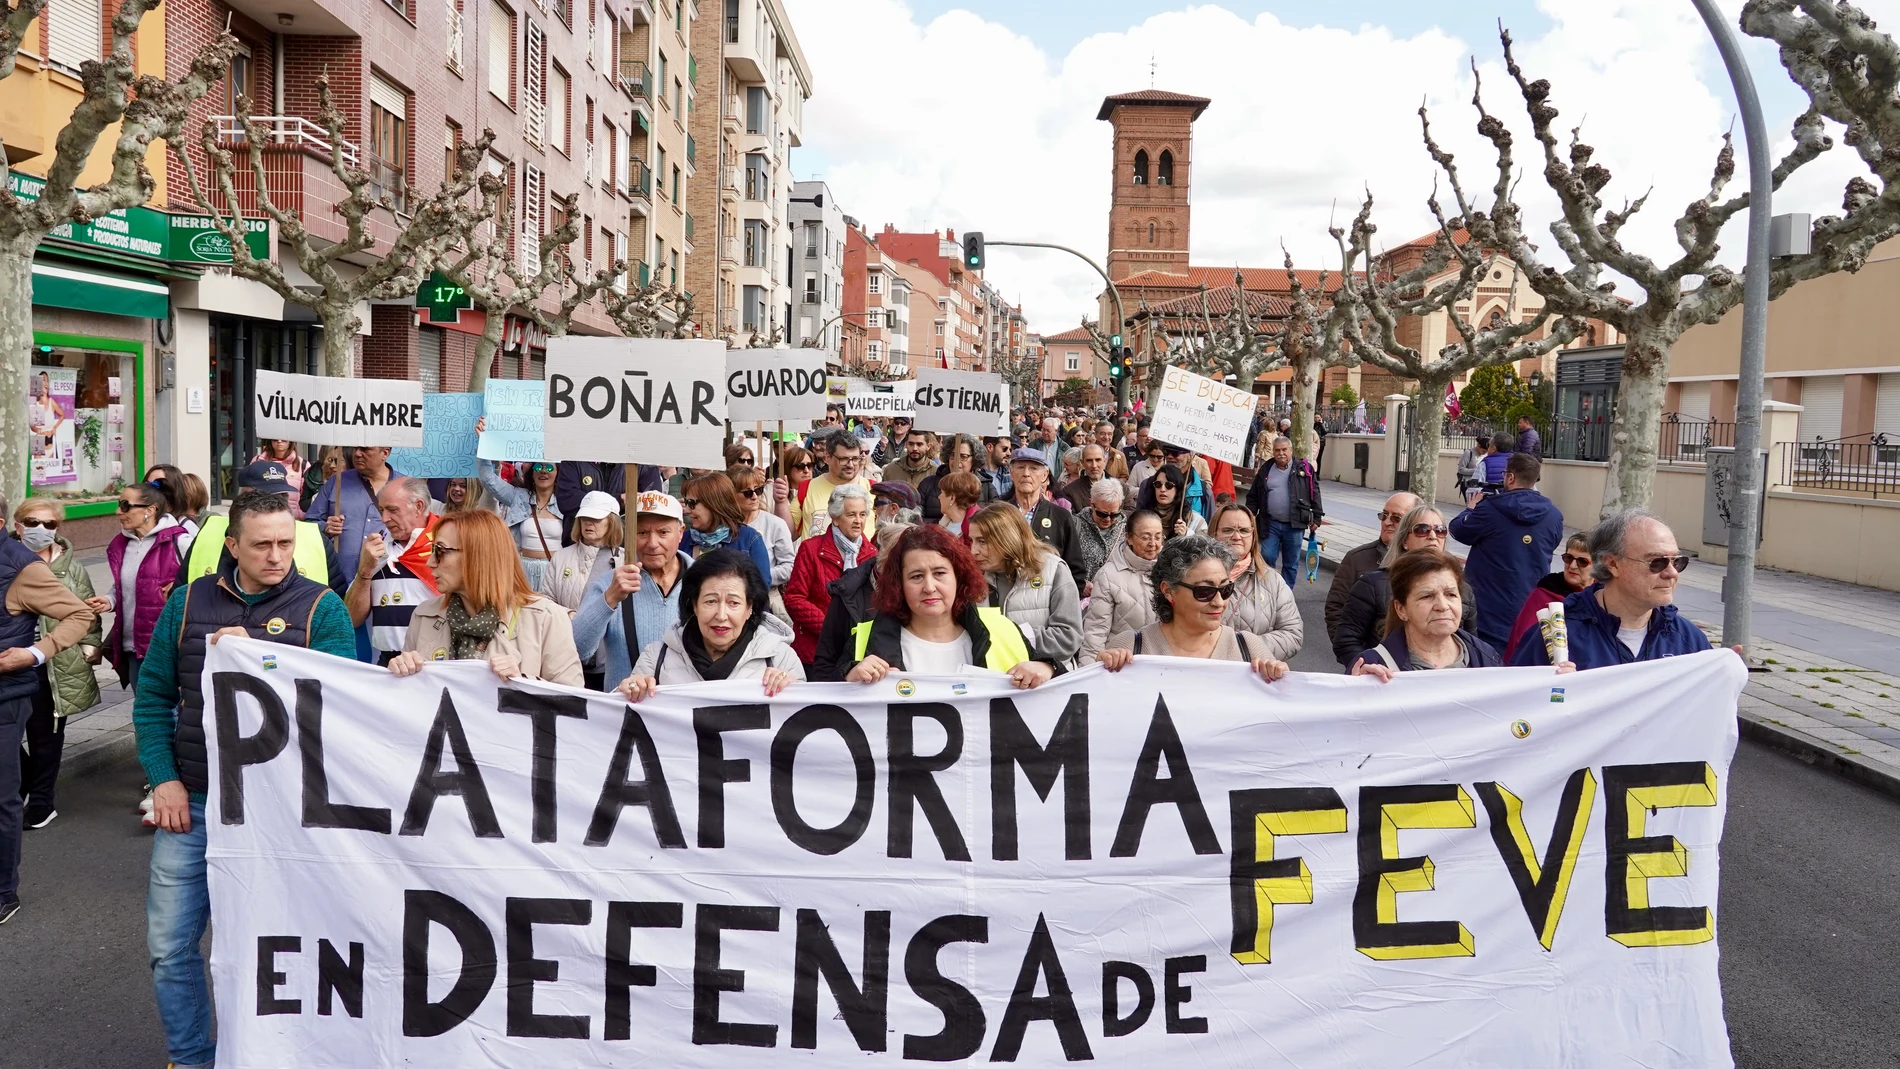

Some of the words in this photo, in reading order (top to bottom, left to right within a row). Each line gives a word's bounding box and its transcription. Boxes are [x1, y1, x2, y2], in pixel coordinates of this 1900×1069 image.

[95, 216, 129, 234] ECOTIENDA
[93, 229, 129, 248] PRODUCTOS
[129, 236, 162, 255] NATURALES
[727, 368, 827, 398] GUARDO
[1165, 371, 1190, 392] SE
[549, 370, 723, 426] BOÑAR
[487, 412, 544, 433] NUESTRO
[1156, 415, 1171, 427] LOS
[1213, 431, 1239, 447] HASTA
[1161, 399, 1180, 410] TREN
[1184, 405, 1217, 423] PERDIDO
[1222, 418, 1247, 433] DESDE
[1152, 429, 1162, 439] EL
[1167, 433, 1199, 449] CENTRO
[1202, 443, 1214, 453] DE
[211, 671, 1223, 862] PLATAFORMA
[1229, 761, 1718, 965] FEVE
[256, 936, 364, 1018] EN
[402, 889, 1095, 1062] DEFENSA
[1102, 955, 1208, 1037] DE
